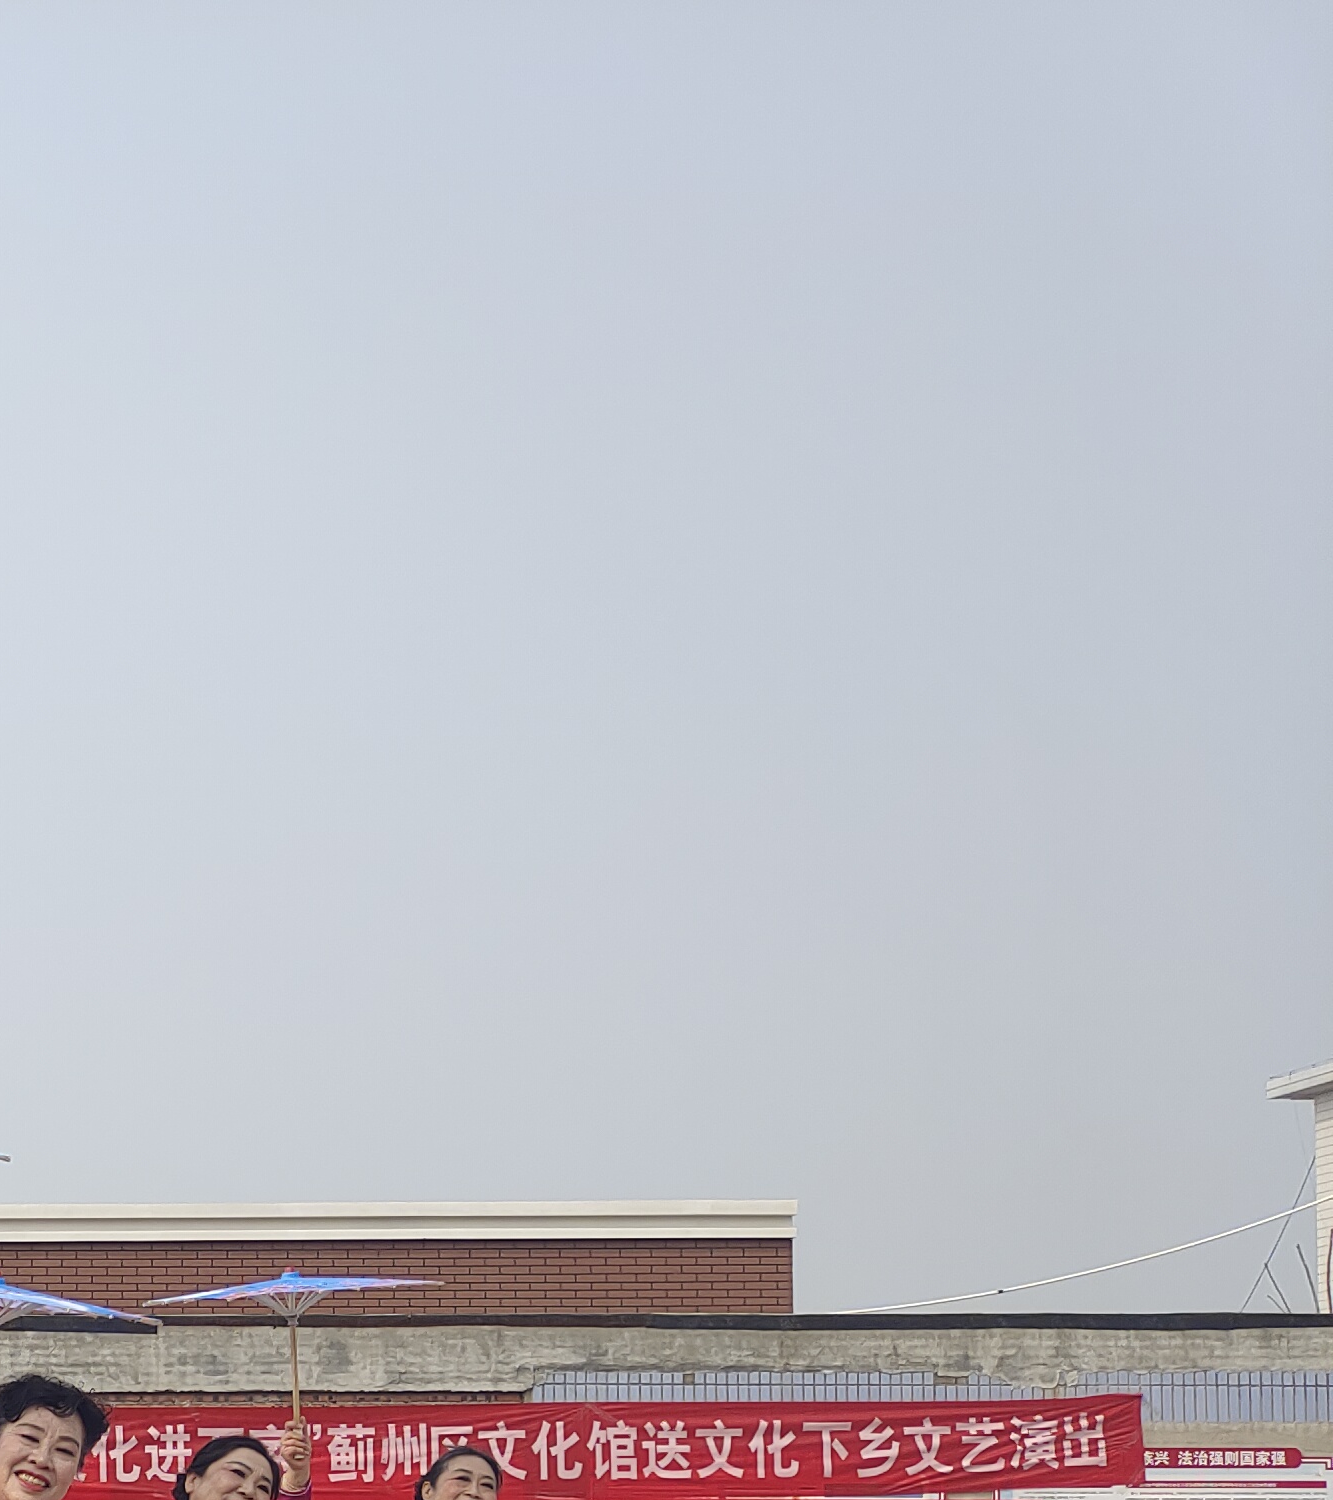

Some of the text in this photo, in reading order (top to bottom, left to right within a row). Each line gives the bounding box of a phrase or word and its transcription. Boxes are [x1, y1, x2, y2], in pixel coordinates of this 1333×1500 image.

[1178, 1451, 1287, 1466] 法治强则国家强
